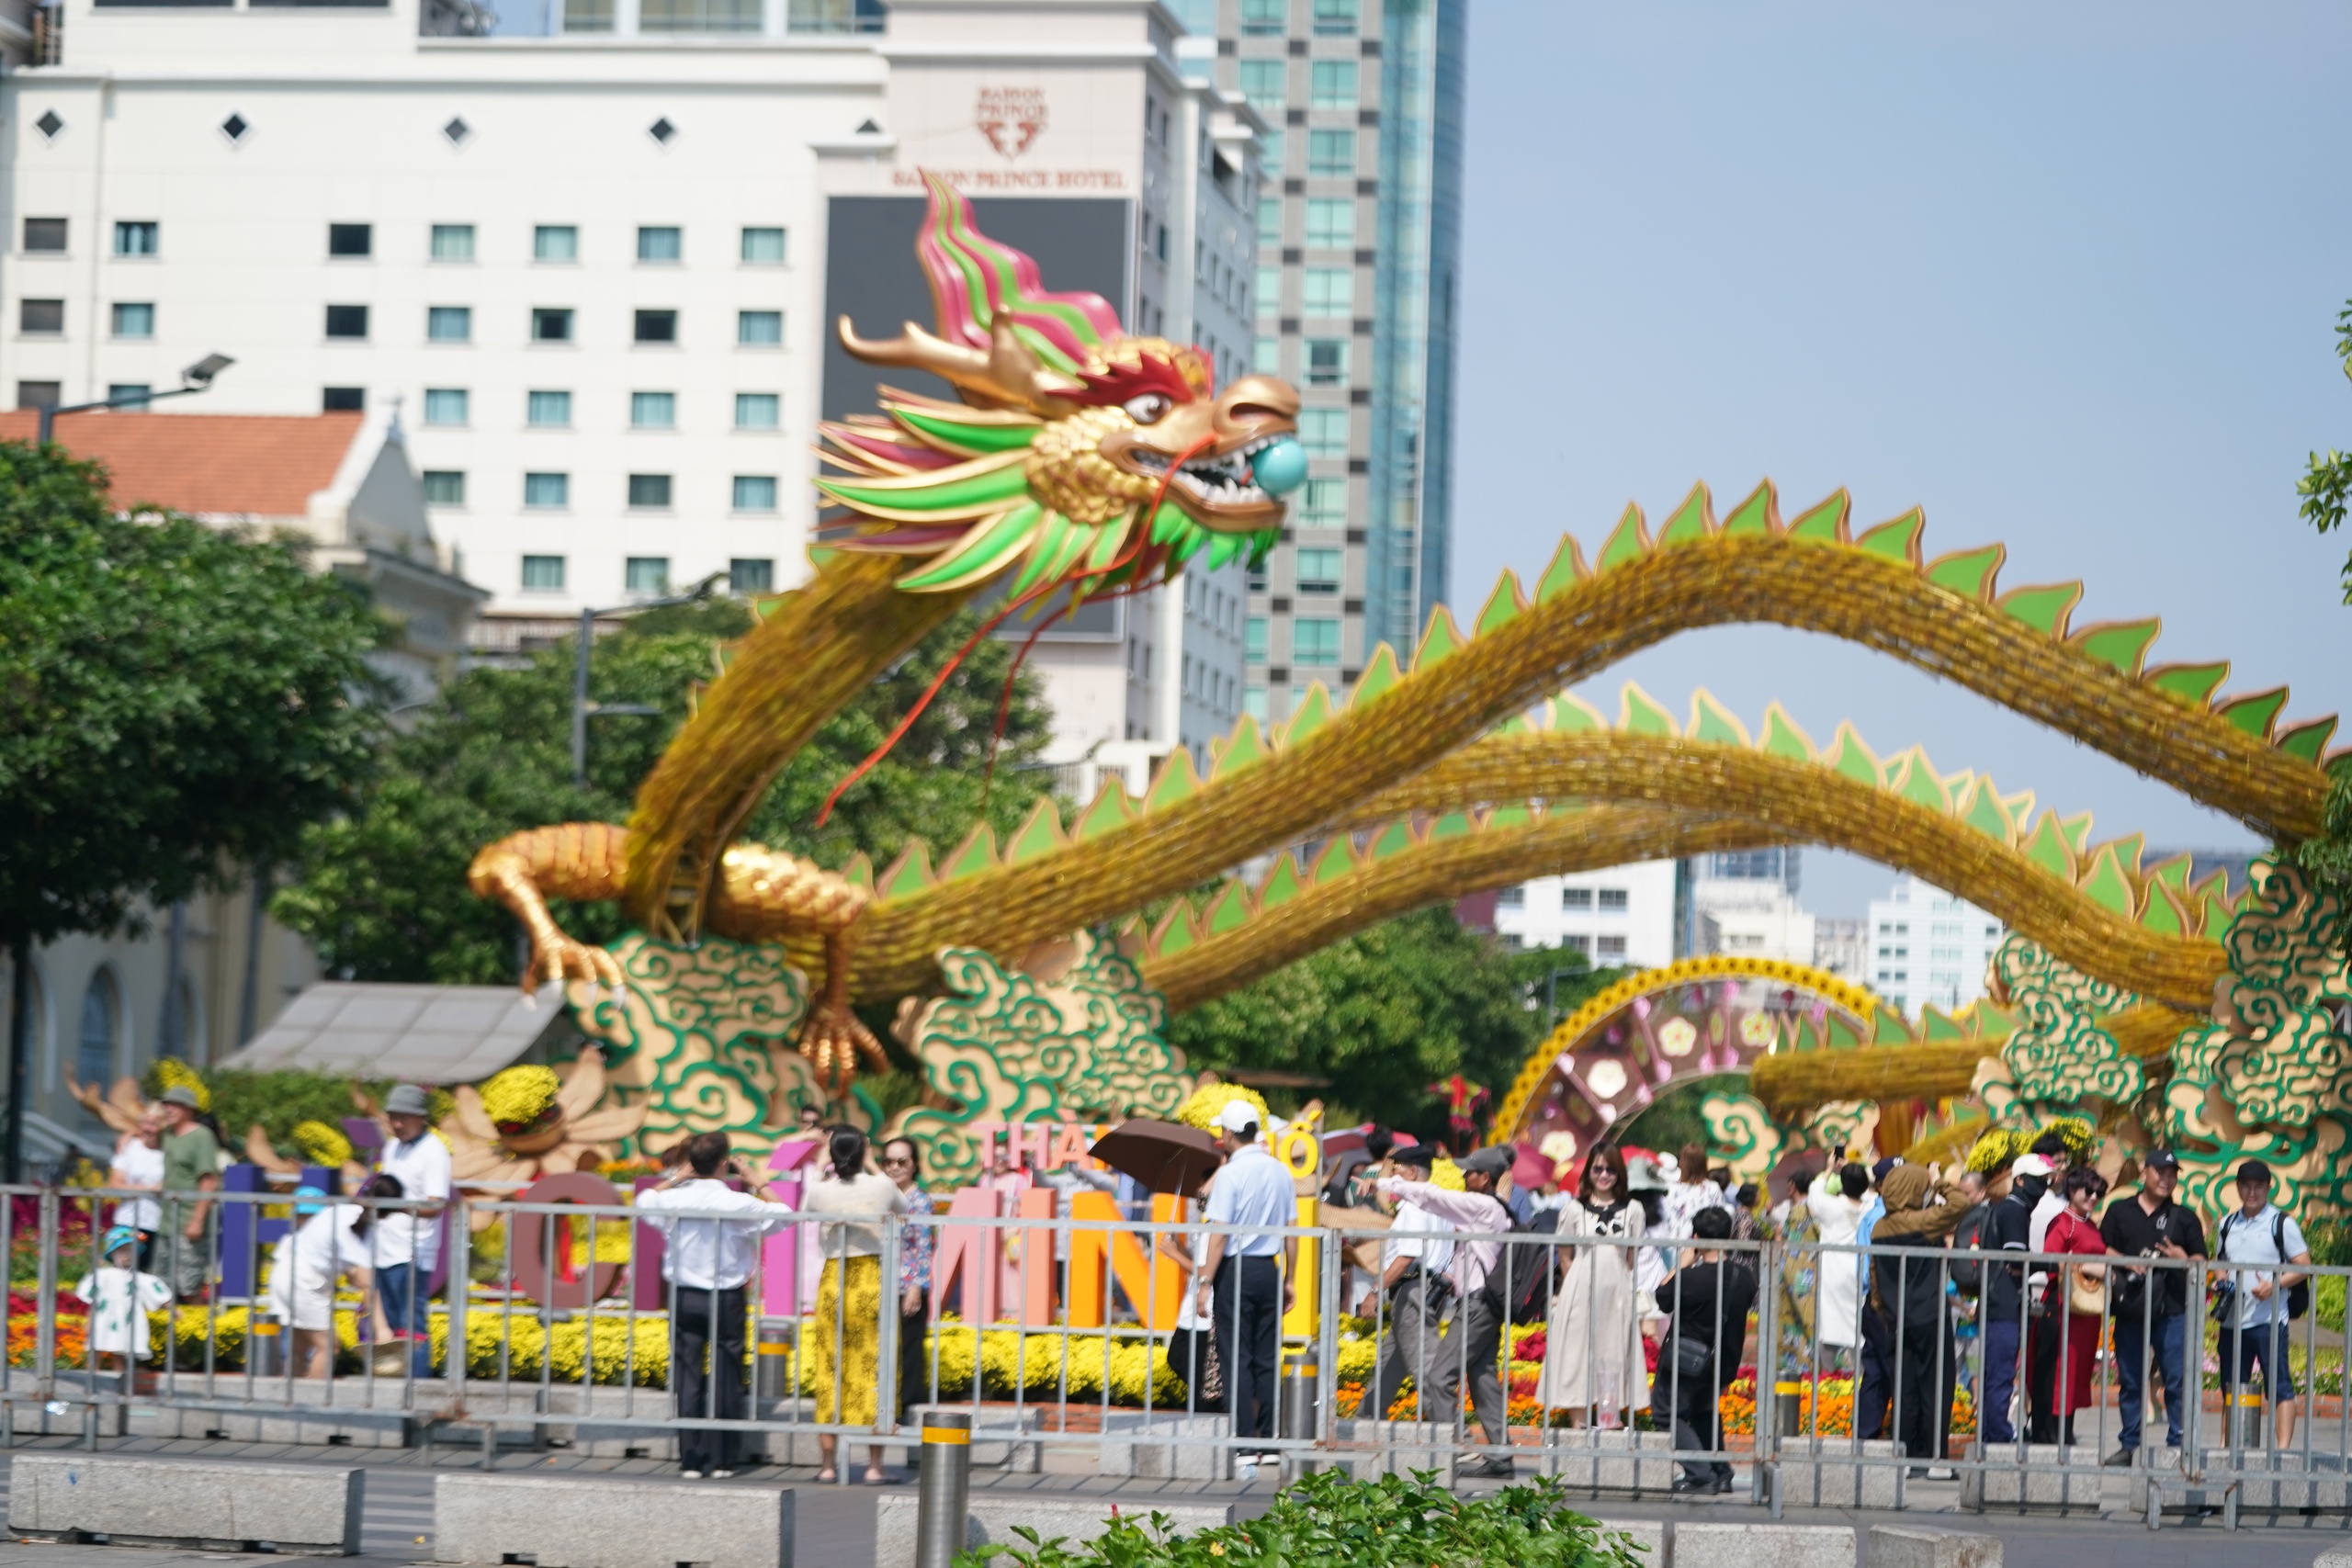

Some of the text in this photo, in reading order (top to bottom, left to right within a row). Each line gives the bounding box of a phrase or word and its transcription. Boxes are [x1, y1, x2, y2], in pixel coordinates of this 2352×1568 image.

[893, 170, 1127, 190] SAON PRINCE HOTEL
[969, 1108, 1114, 1171] THÀ
